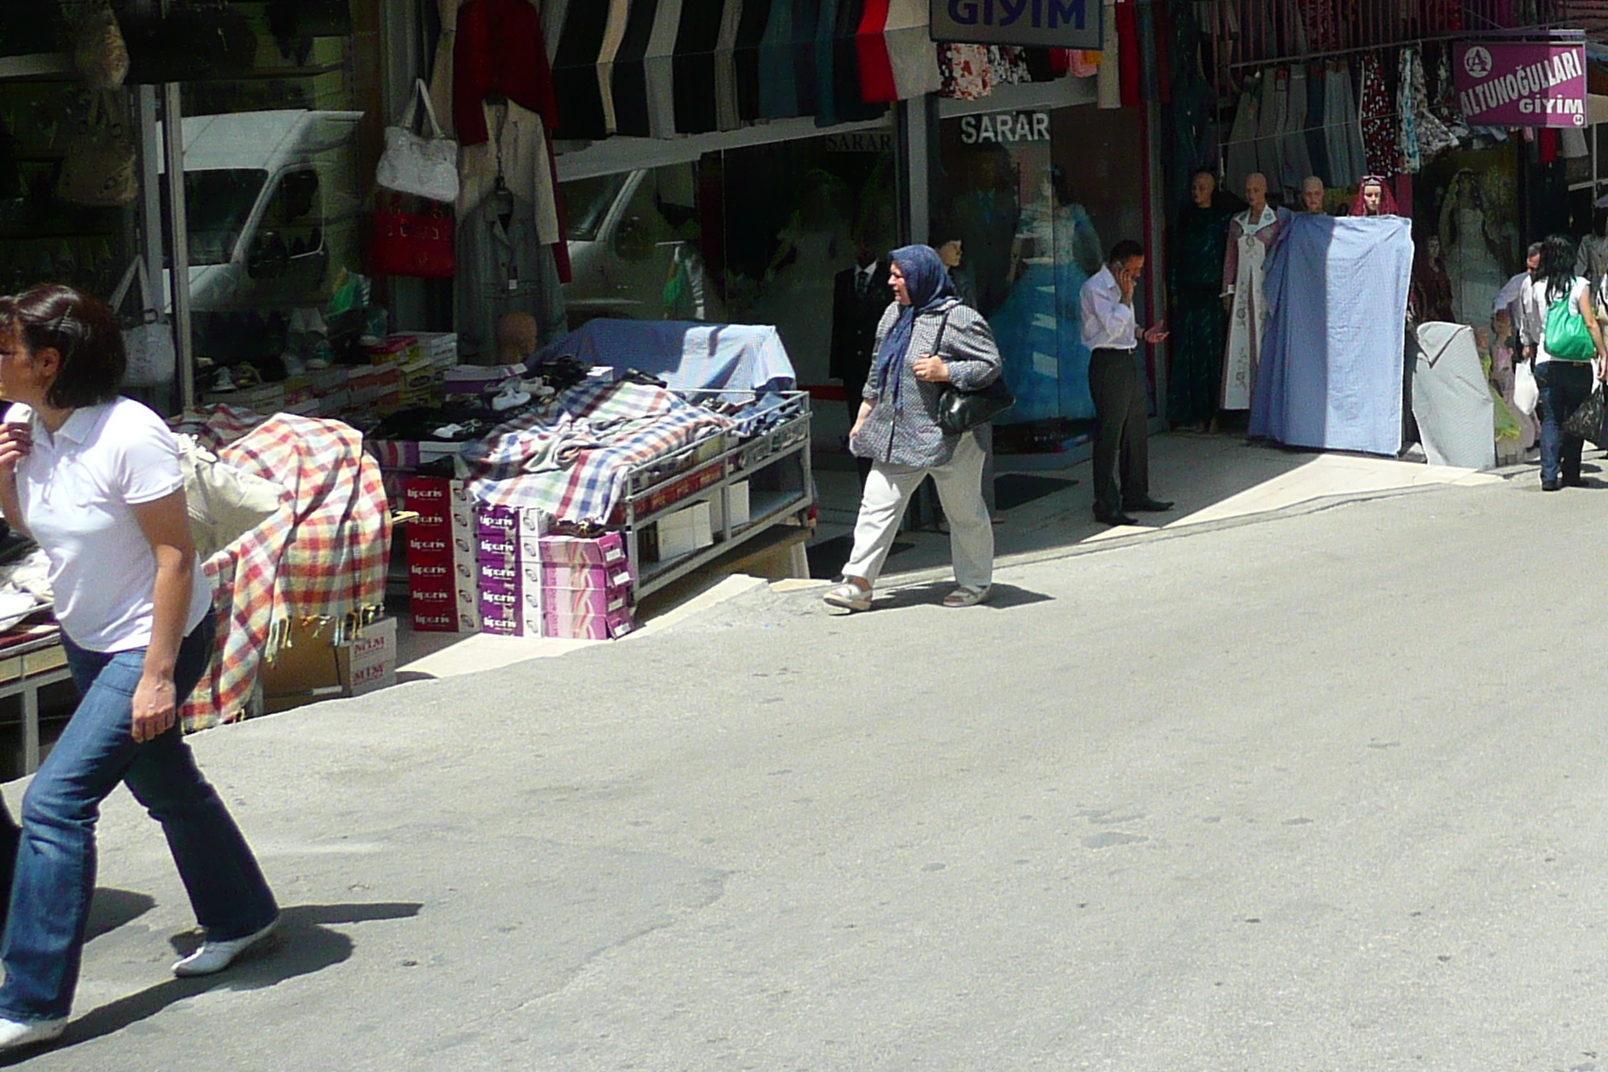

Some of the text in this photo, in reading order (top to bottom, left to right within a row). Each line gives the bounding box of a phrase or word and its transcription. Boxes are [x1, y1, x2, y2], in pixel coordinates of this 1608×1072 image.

[1460, 48, 1583, 118] ALTUNOĞULLARI
[1519, 94, 1584, 114] GİYİM
[961, 113, 1051, 144] SARAR
